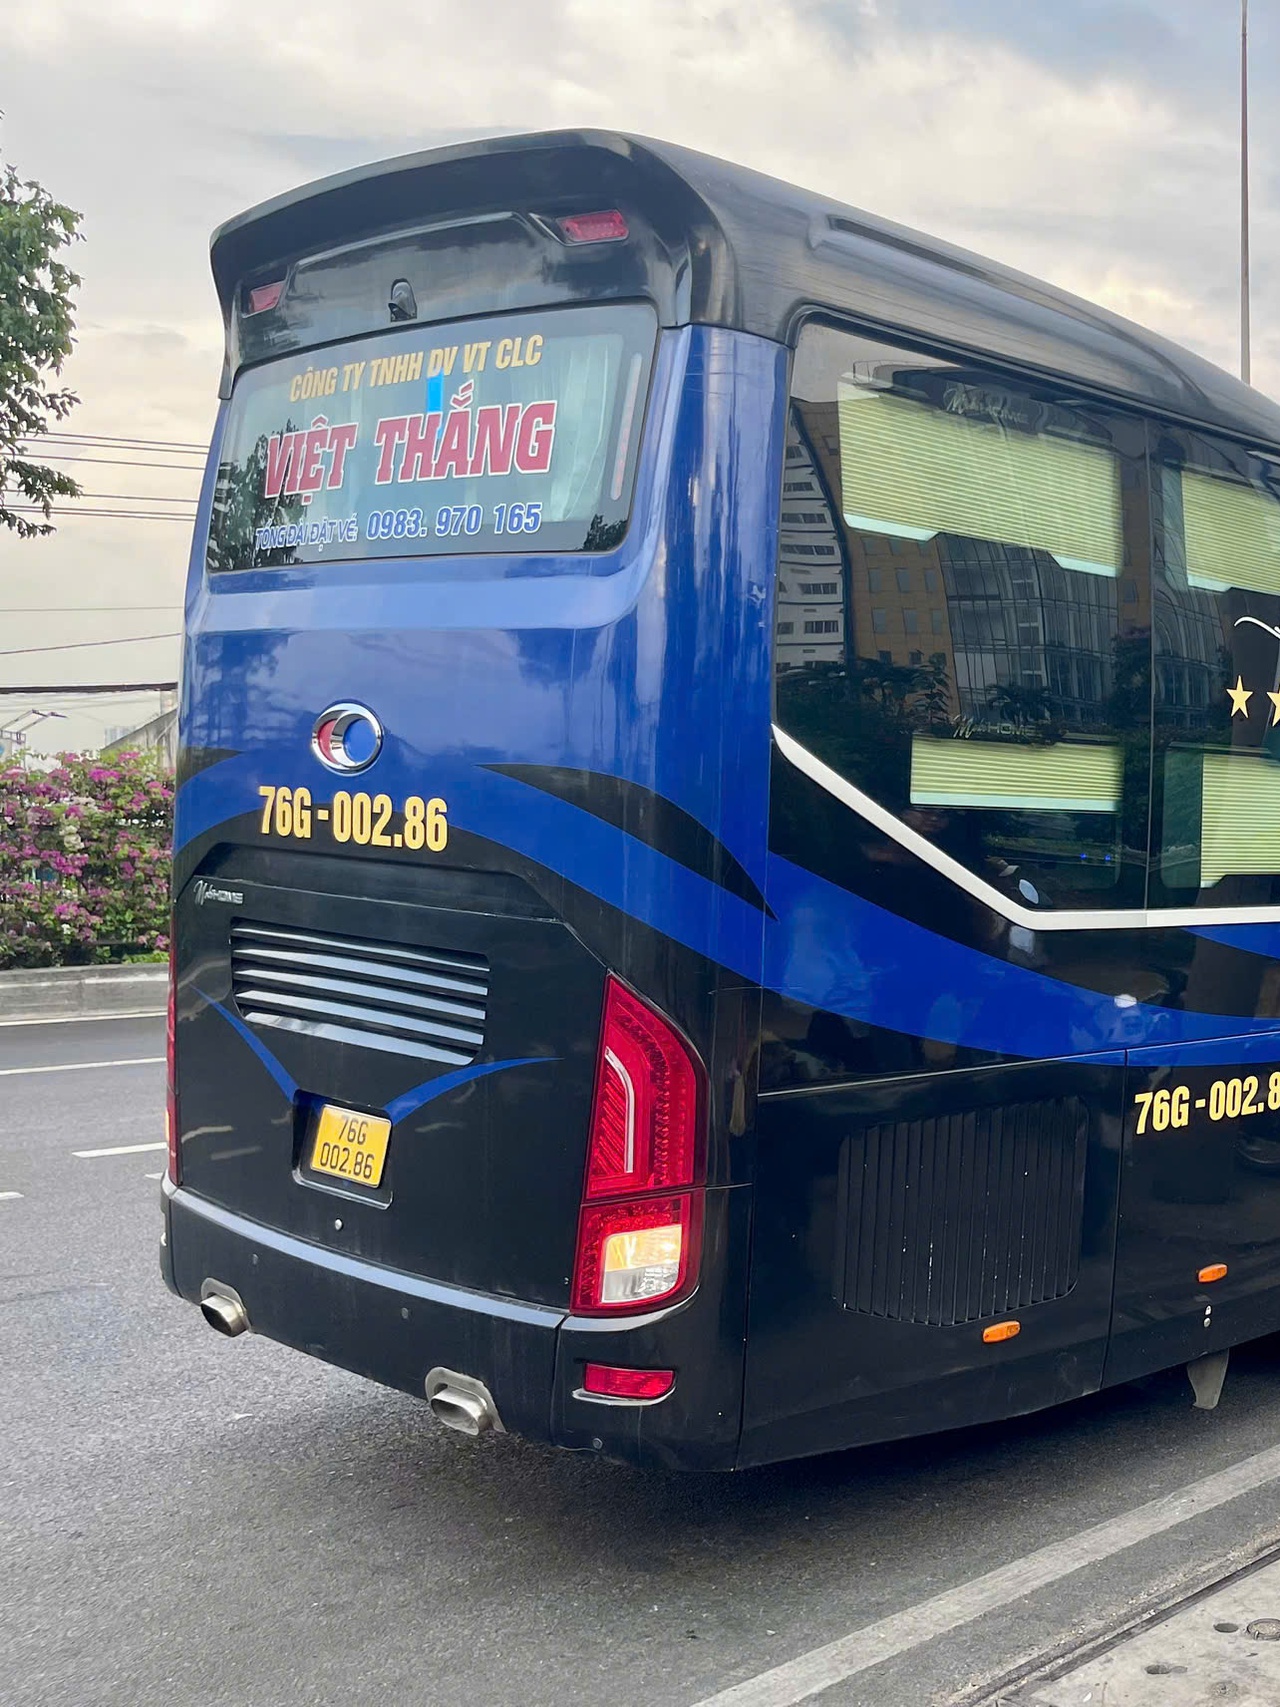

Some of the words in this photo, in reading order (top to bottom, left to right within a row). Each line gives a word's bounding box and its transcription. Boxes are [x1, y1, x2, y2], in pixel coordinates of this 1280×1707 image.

[290, 366, 337, 401] CÔNG
[343, 361, 367, 391] TY
[370, 352, 424, 387] TNHH
[427, 346, 459, 376] DV
[462, 341, 492, 373] VT
[495, 334, 544, 368] CLC
[264, 414, 359, 506] VIỆT
[374, 379, 558, 486] THẮNG
[255, 517, 286, 550] TỔNG
[286, 518, 308, 547] ĐÀI
[309, 515, 337, 552] ĐẶT
[366, 508, 427, 540] 0983.
[435, 505, 482, 537] 970
[493, 502, 542, 535] 165
[259, 786, 448, 852] 76G-002.86
[338, 1117, 368, 1145] 76G
[320, 1142, 375, 1179] 002.86
